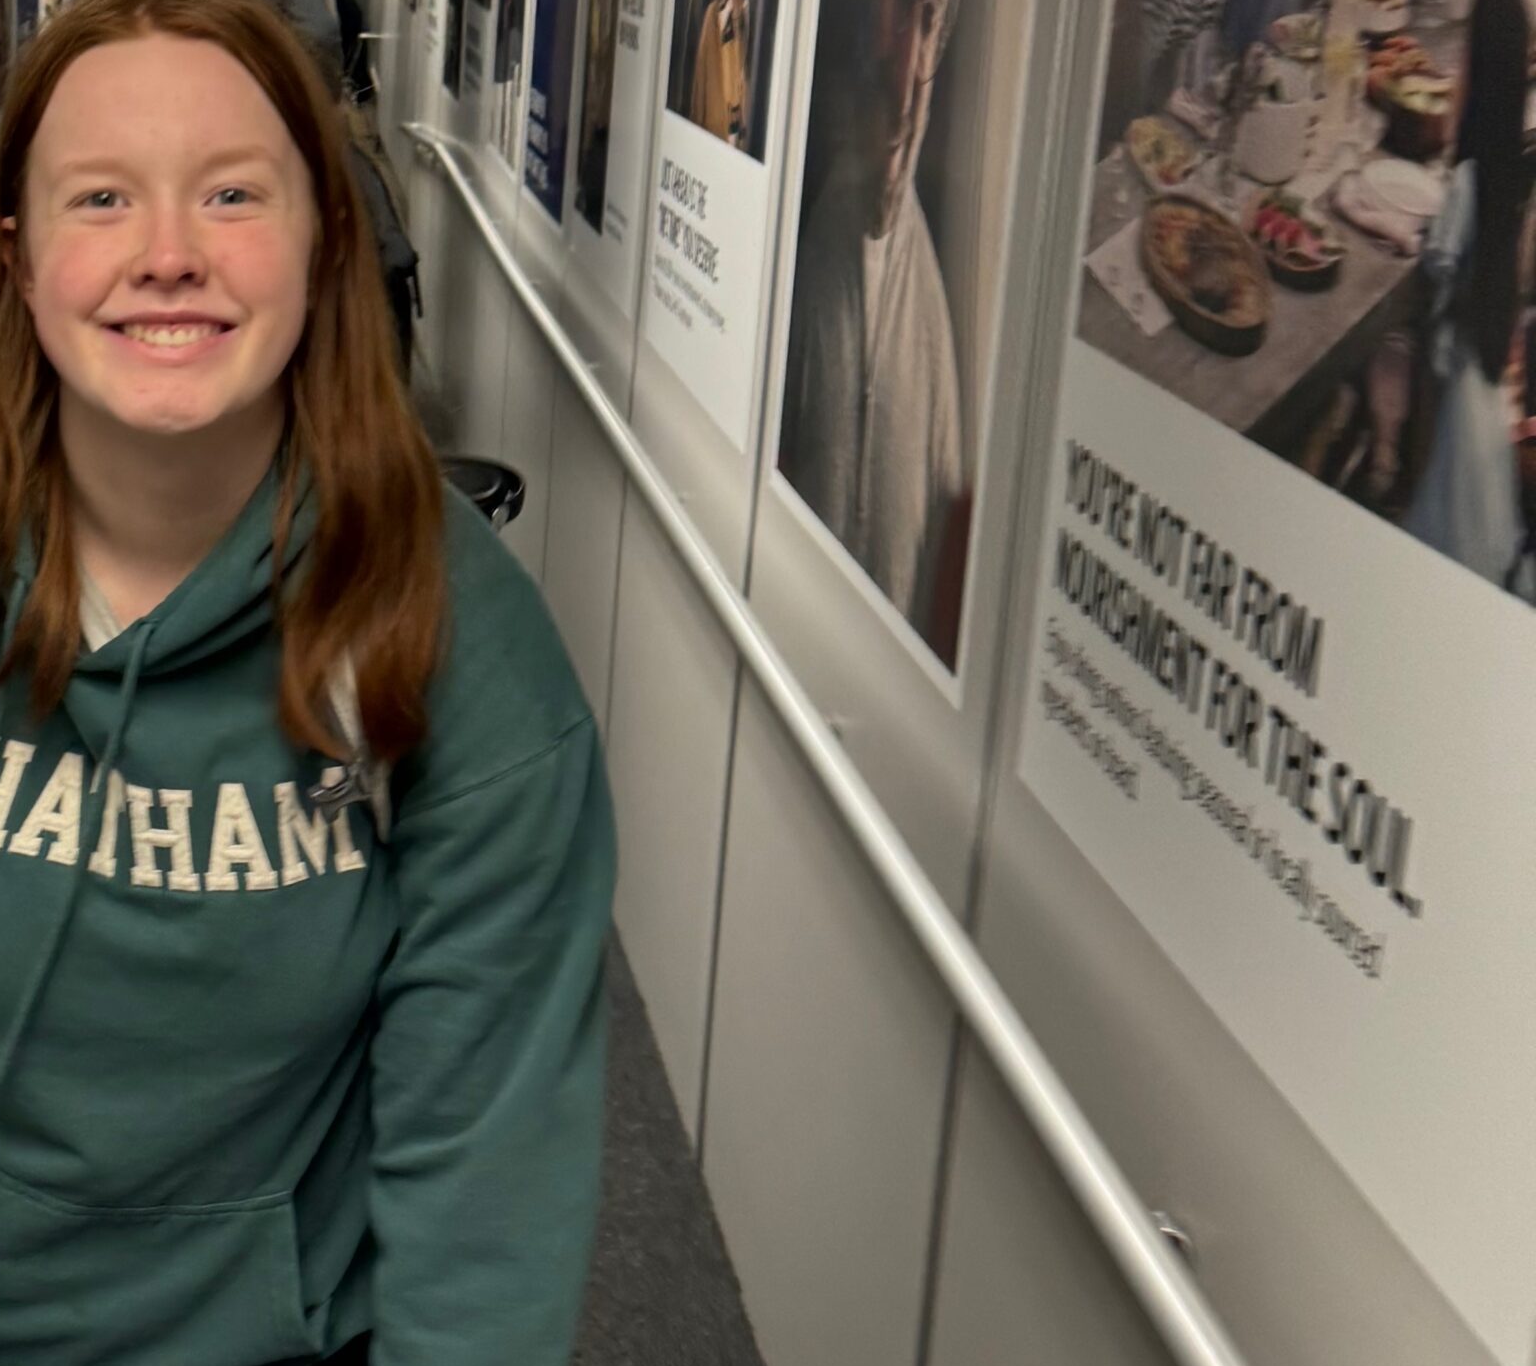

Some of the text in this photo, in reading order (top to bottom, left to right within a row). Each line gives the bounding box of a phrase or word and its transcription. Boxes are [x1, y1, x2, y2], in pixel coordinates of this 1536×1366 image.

[1052, 527, 1208, 713] NOURISHMENT
[1205, 657, 1263, 768] FOR
[1265, 705, 1326, 824] THE
[1065, 439, 1324, 698] YOU'RE NOT FAR FROM
